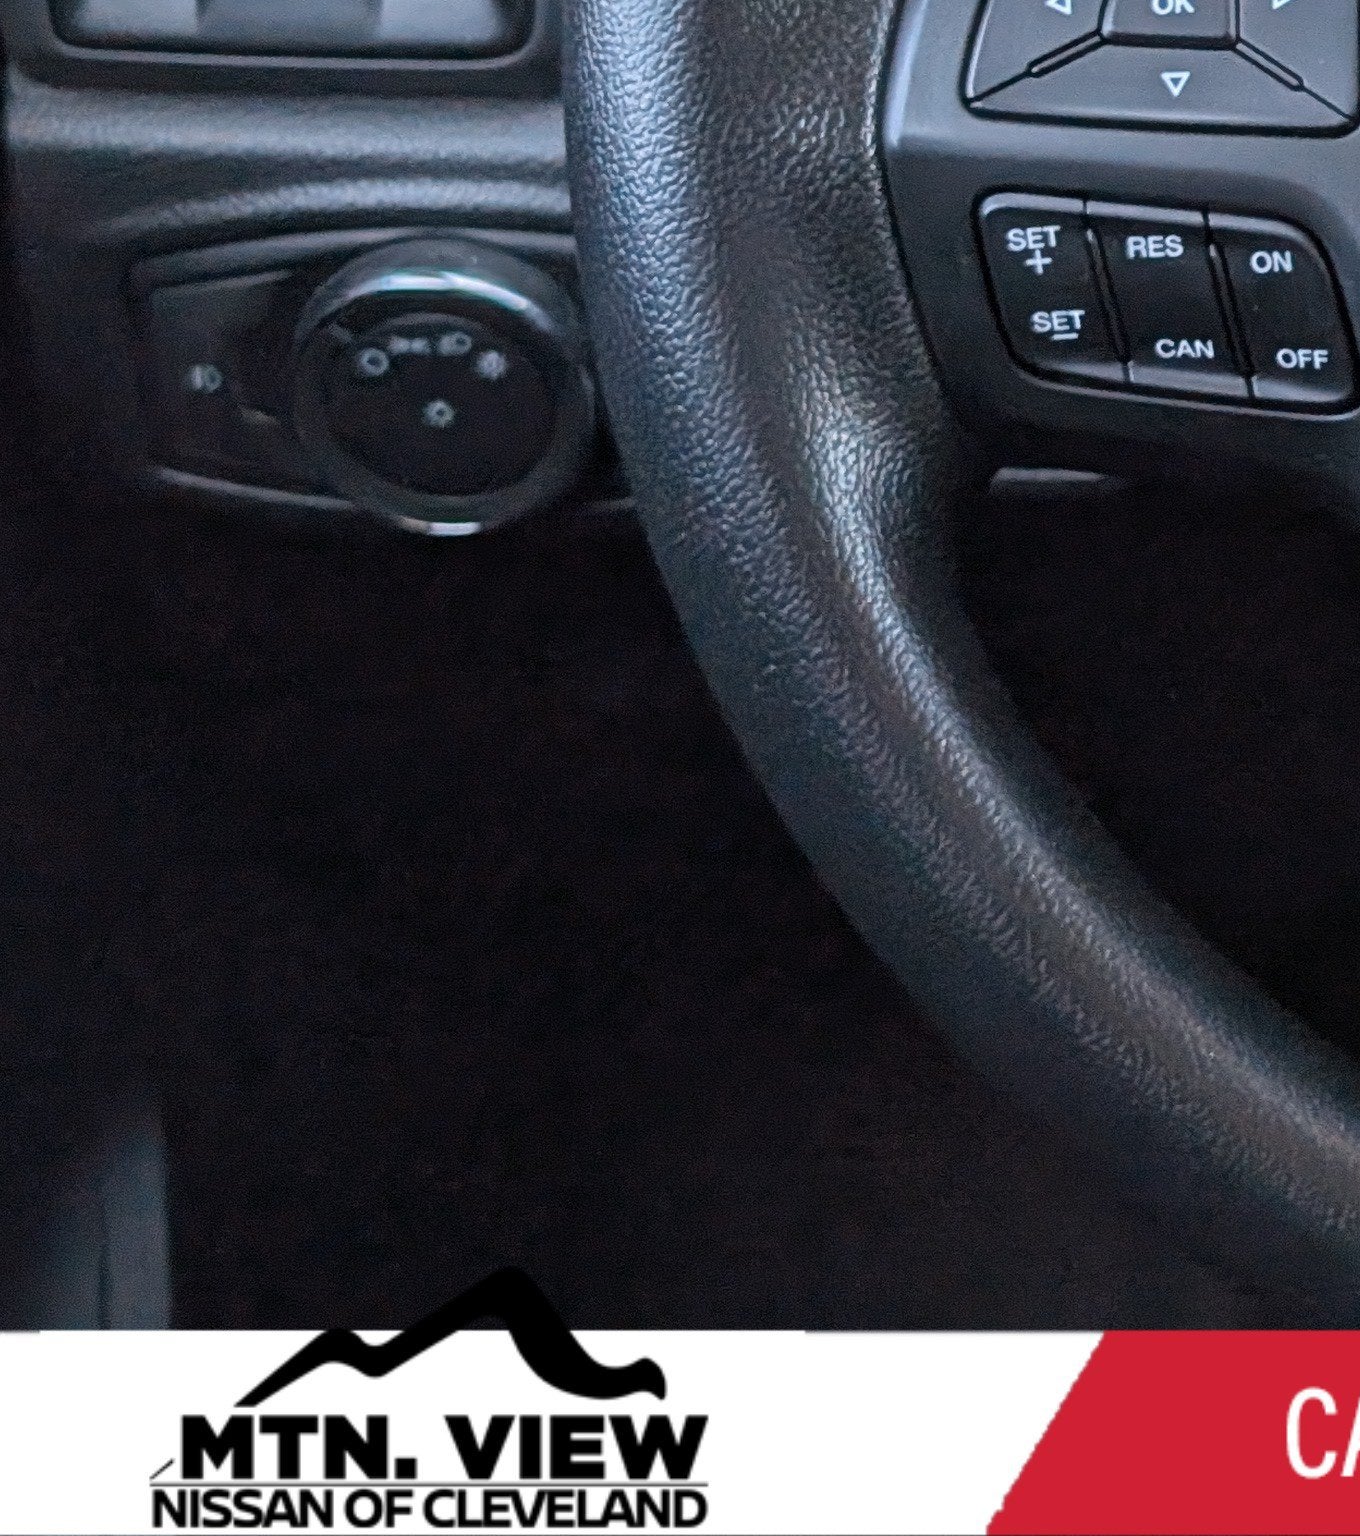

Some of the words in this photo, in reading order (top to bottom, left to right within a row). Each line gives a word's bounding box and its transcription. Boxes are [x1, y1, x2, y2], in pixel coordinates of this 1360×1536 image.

[1007, 224, 1061, 252] SET
[1126, 234, 1184, 260] RES
[1250, 250, 1293, 274] ON
[1031, 308, 1086, 334] SET
[1155, 338, 1215, 359] CAN
[1276, 348, 1329, 370] OFF
